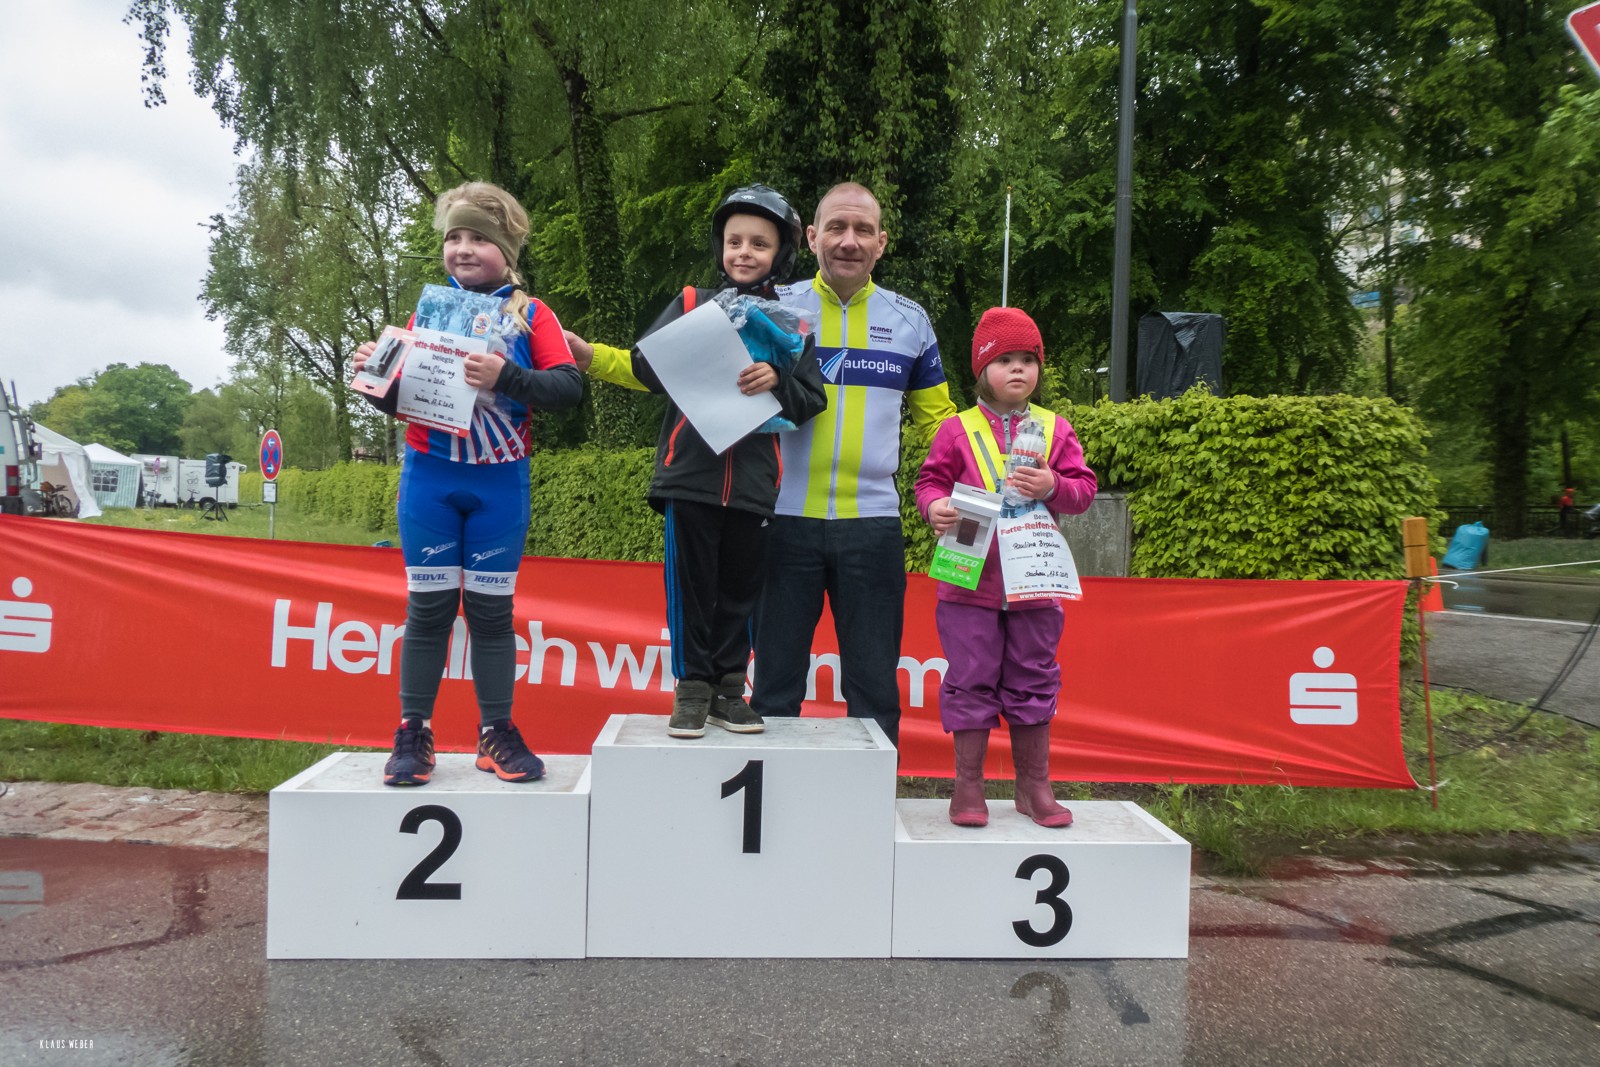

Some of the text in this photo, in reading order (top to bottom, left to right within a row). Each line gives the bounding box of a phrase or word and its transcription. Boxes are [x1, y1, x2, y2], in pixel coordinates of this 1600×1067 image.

[414, 340, 470, 358] ette-Reifen-Ren
[844, 359, 902, 374] autoglas
[271, 598, 577, 686] Herlh
[395, 804, 463, 900] 2
[720, 759, 764, 854] 1
[1012, 853, 1073, 948] 3
